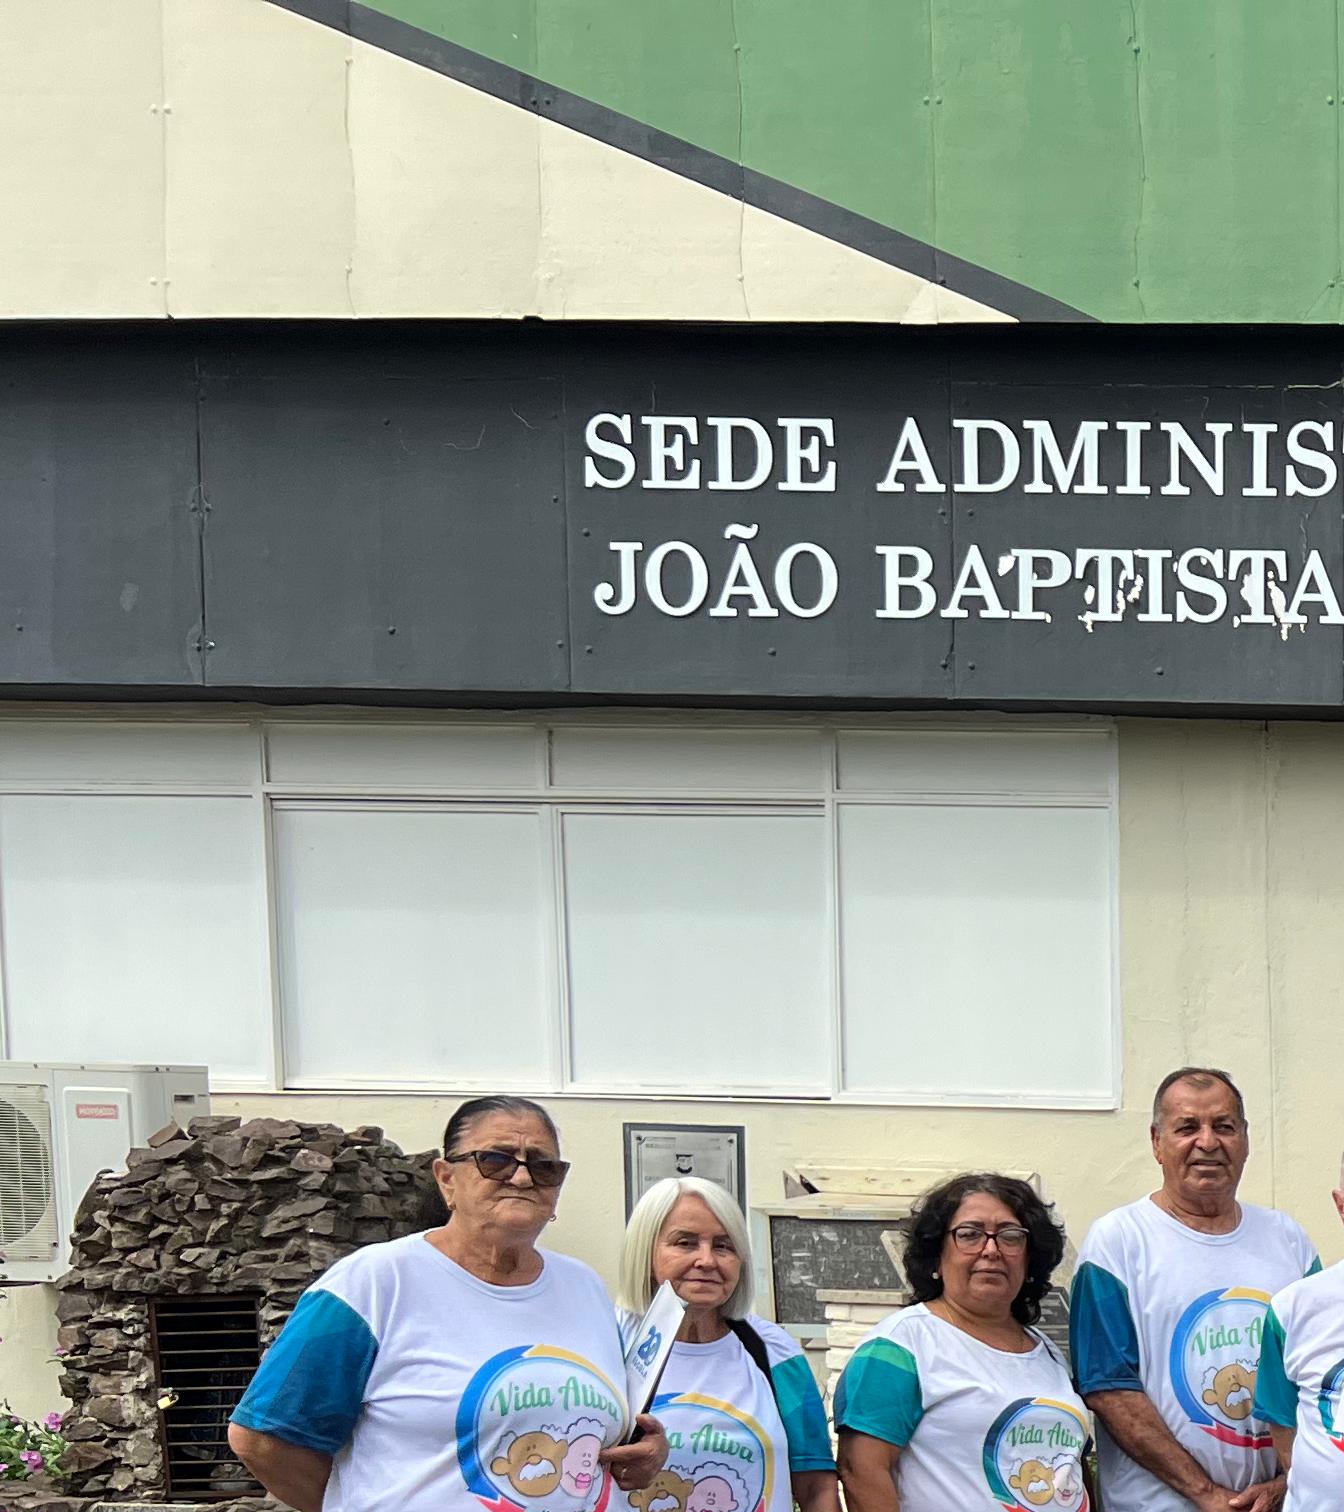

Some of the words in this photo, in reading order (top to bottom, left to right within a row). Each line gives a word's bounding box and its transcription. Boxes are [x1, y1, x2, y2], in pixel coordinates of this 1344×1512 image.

[584, 413, 837, 492] SEDE
[593, 523, 838, 618] JOÃO
[1192, 1324, 1242, 1356] Vida
[490, 1381, 554, 1417] Vida
[558, 1376, 620, 1422] Ativa
[690, 1424, 754, 1463] Ativa
[1006, 1422, 1044, 1447] Vida
